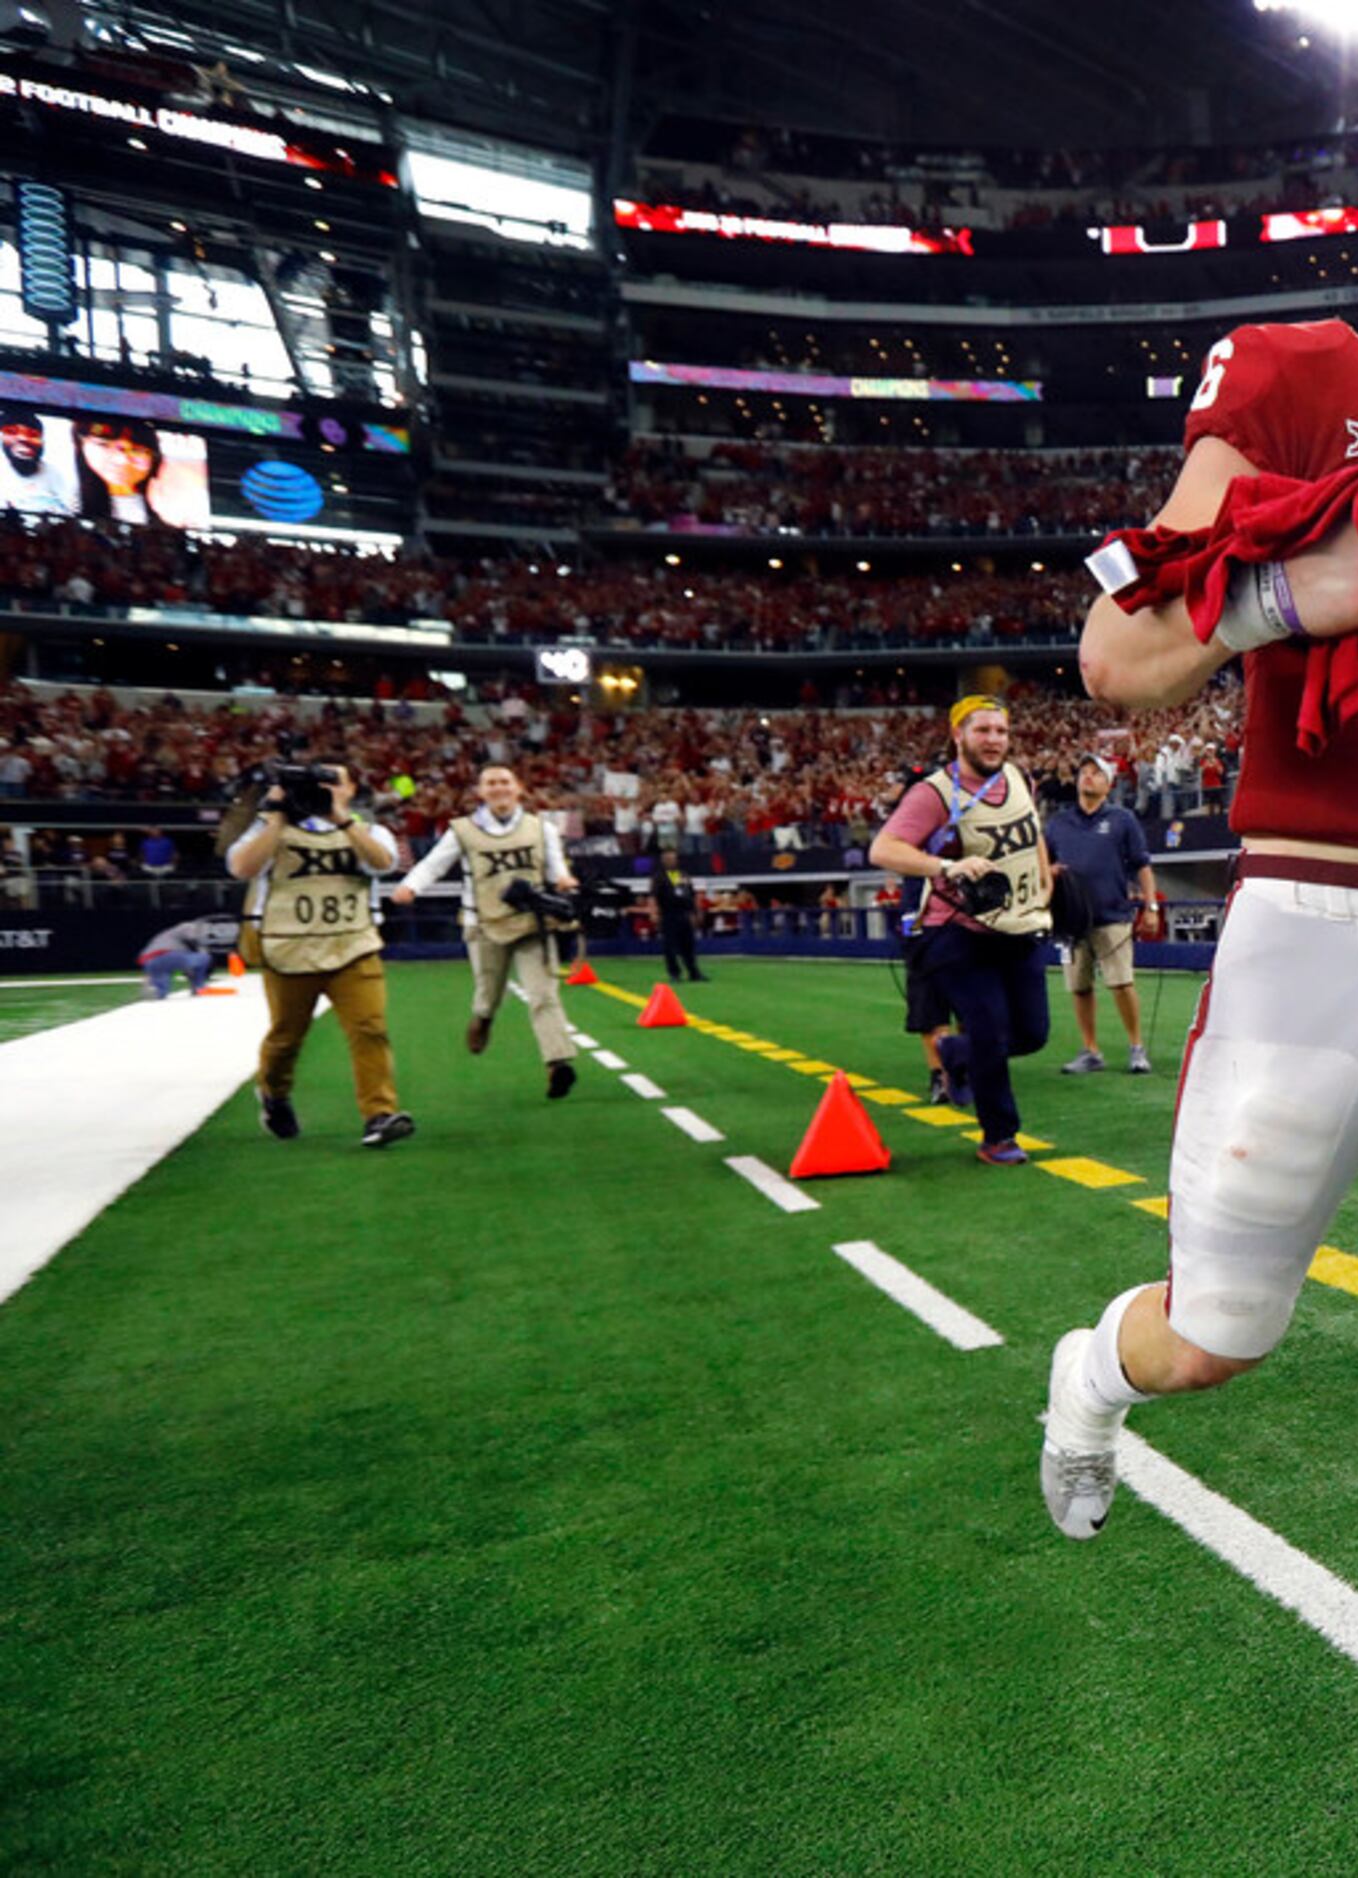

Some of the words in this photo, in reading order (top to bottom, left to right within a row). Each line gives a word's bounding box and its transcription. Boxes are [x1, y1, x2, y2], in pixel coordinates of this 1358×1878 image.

[1190, 339, 1234, 411] 6
[479, 846, 536, 878] XII
[0, 929, 54, 948] T&T
